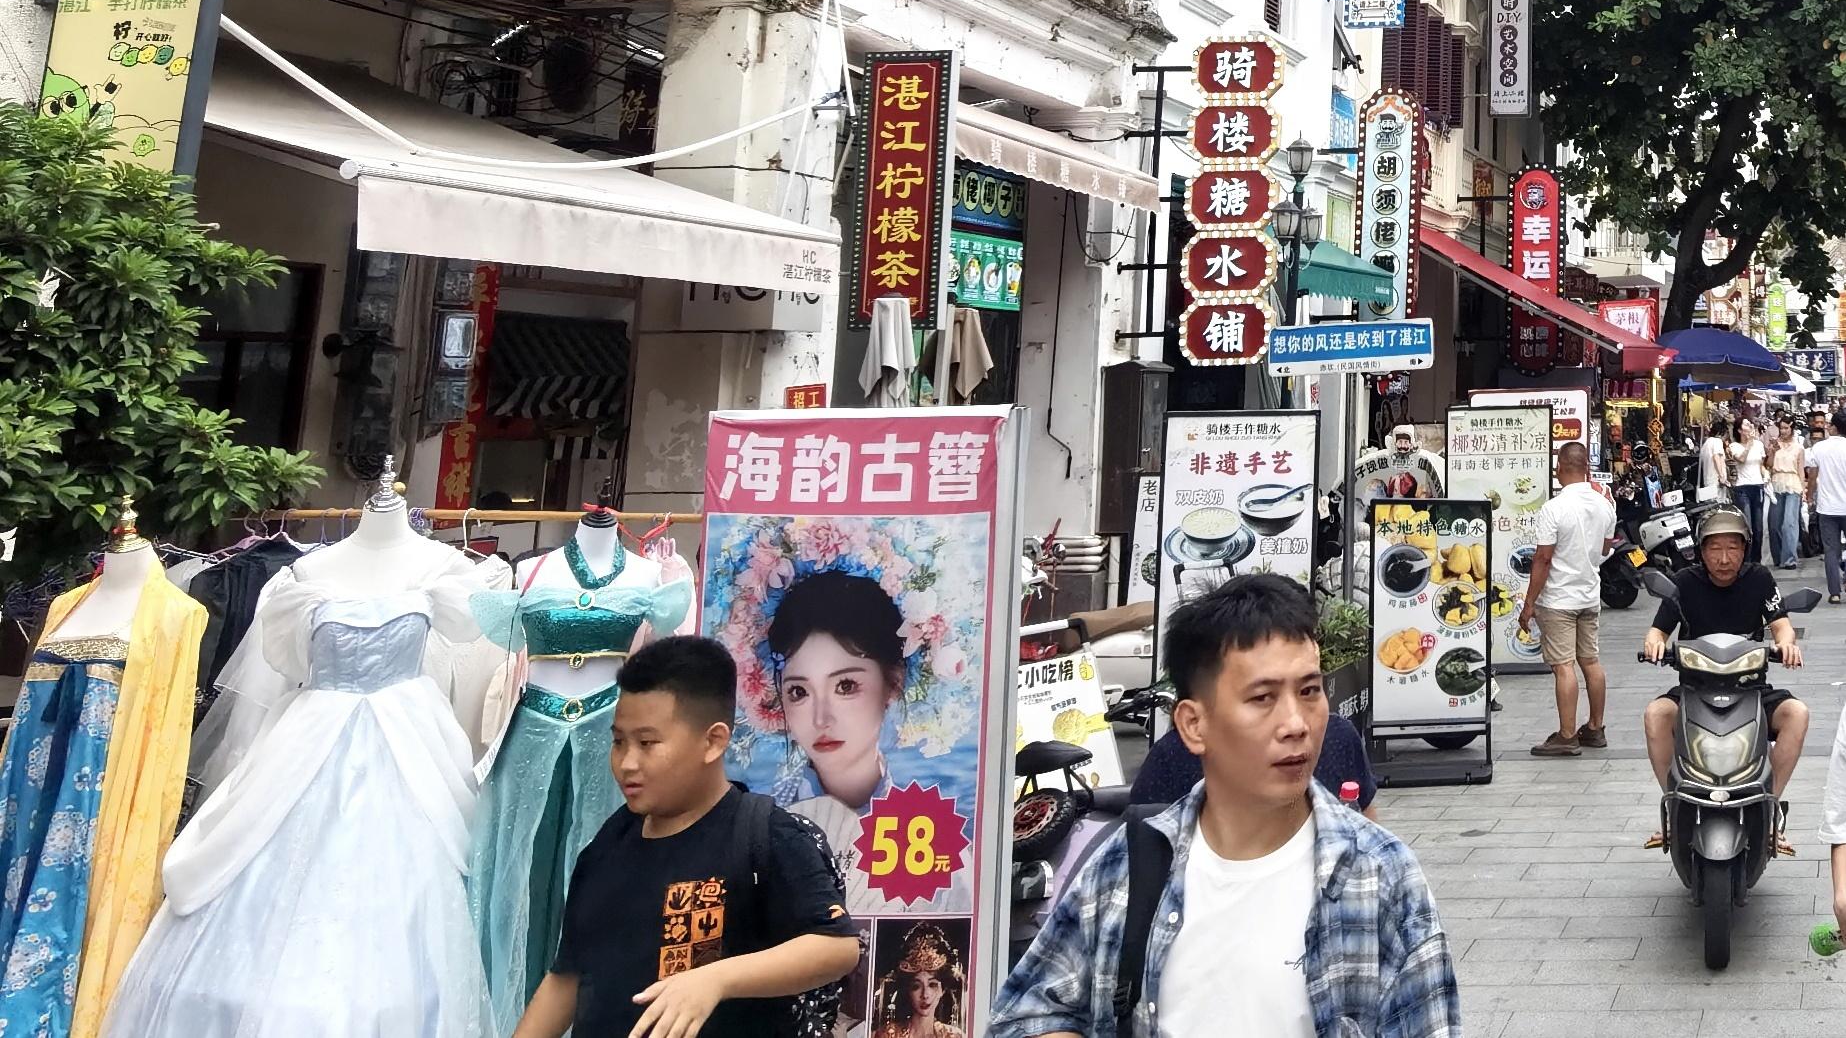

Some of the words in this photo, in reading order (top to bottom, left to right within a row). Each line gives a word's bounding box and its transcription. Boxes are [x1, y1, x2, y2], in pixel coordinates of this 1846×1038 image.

[871, 75, 930, 289] 湛江柠檬茶
[1203, 50, 1257, 353] 骑楼糖水铺
[803, 251, 817, 264] HC
[1522, 214, 1551, 280] 幸运
[783, 263, 832, 284] 湛江柠檬茶
[1273, 328, 1426, 355] 想你的风还是吹到了湛江
[793, 392, 820, 410] 招工
[1206, 423, 1281, 436] 骑楼手作糖水
[1452, 432, 1547, 453] 椰奶清补凉
[719, 431, 990, 503] 海韵古簪
[1189, 450, 1293, 476] 非遗手艺
[1141, 479, 1158, 512] 老店
[1175, 488, 1225, 506] 双皮奶
[1377, 519, 1485, 538] 本地特色糖水
[1259, 537, 1308, 556] 姜撞奶
[870, 816, 951, 876] 58元
